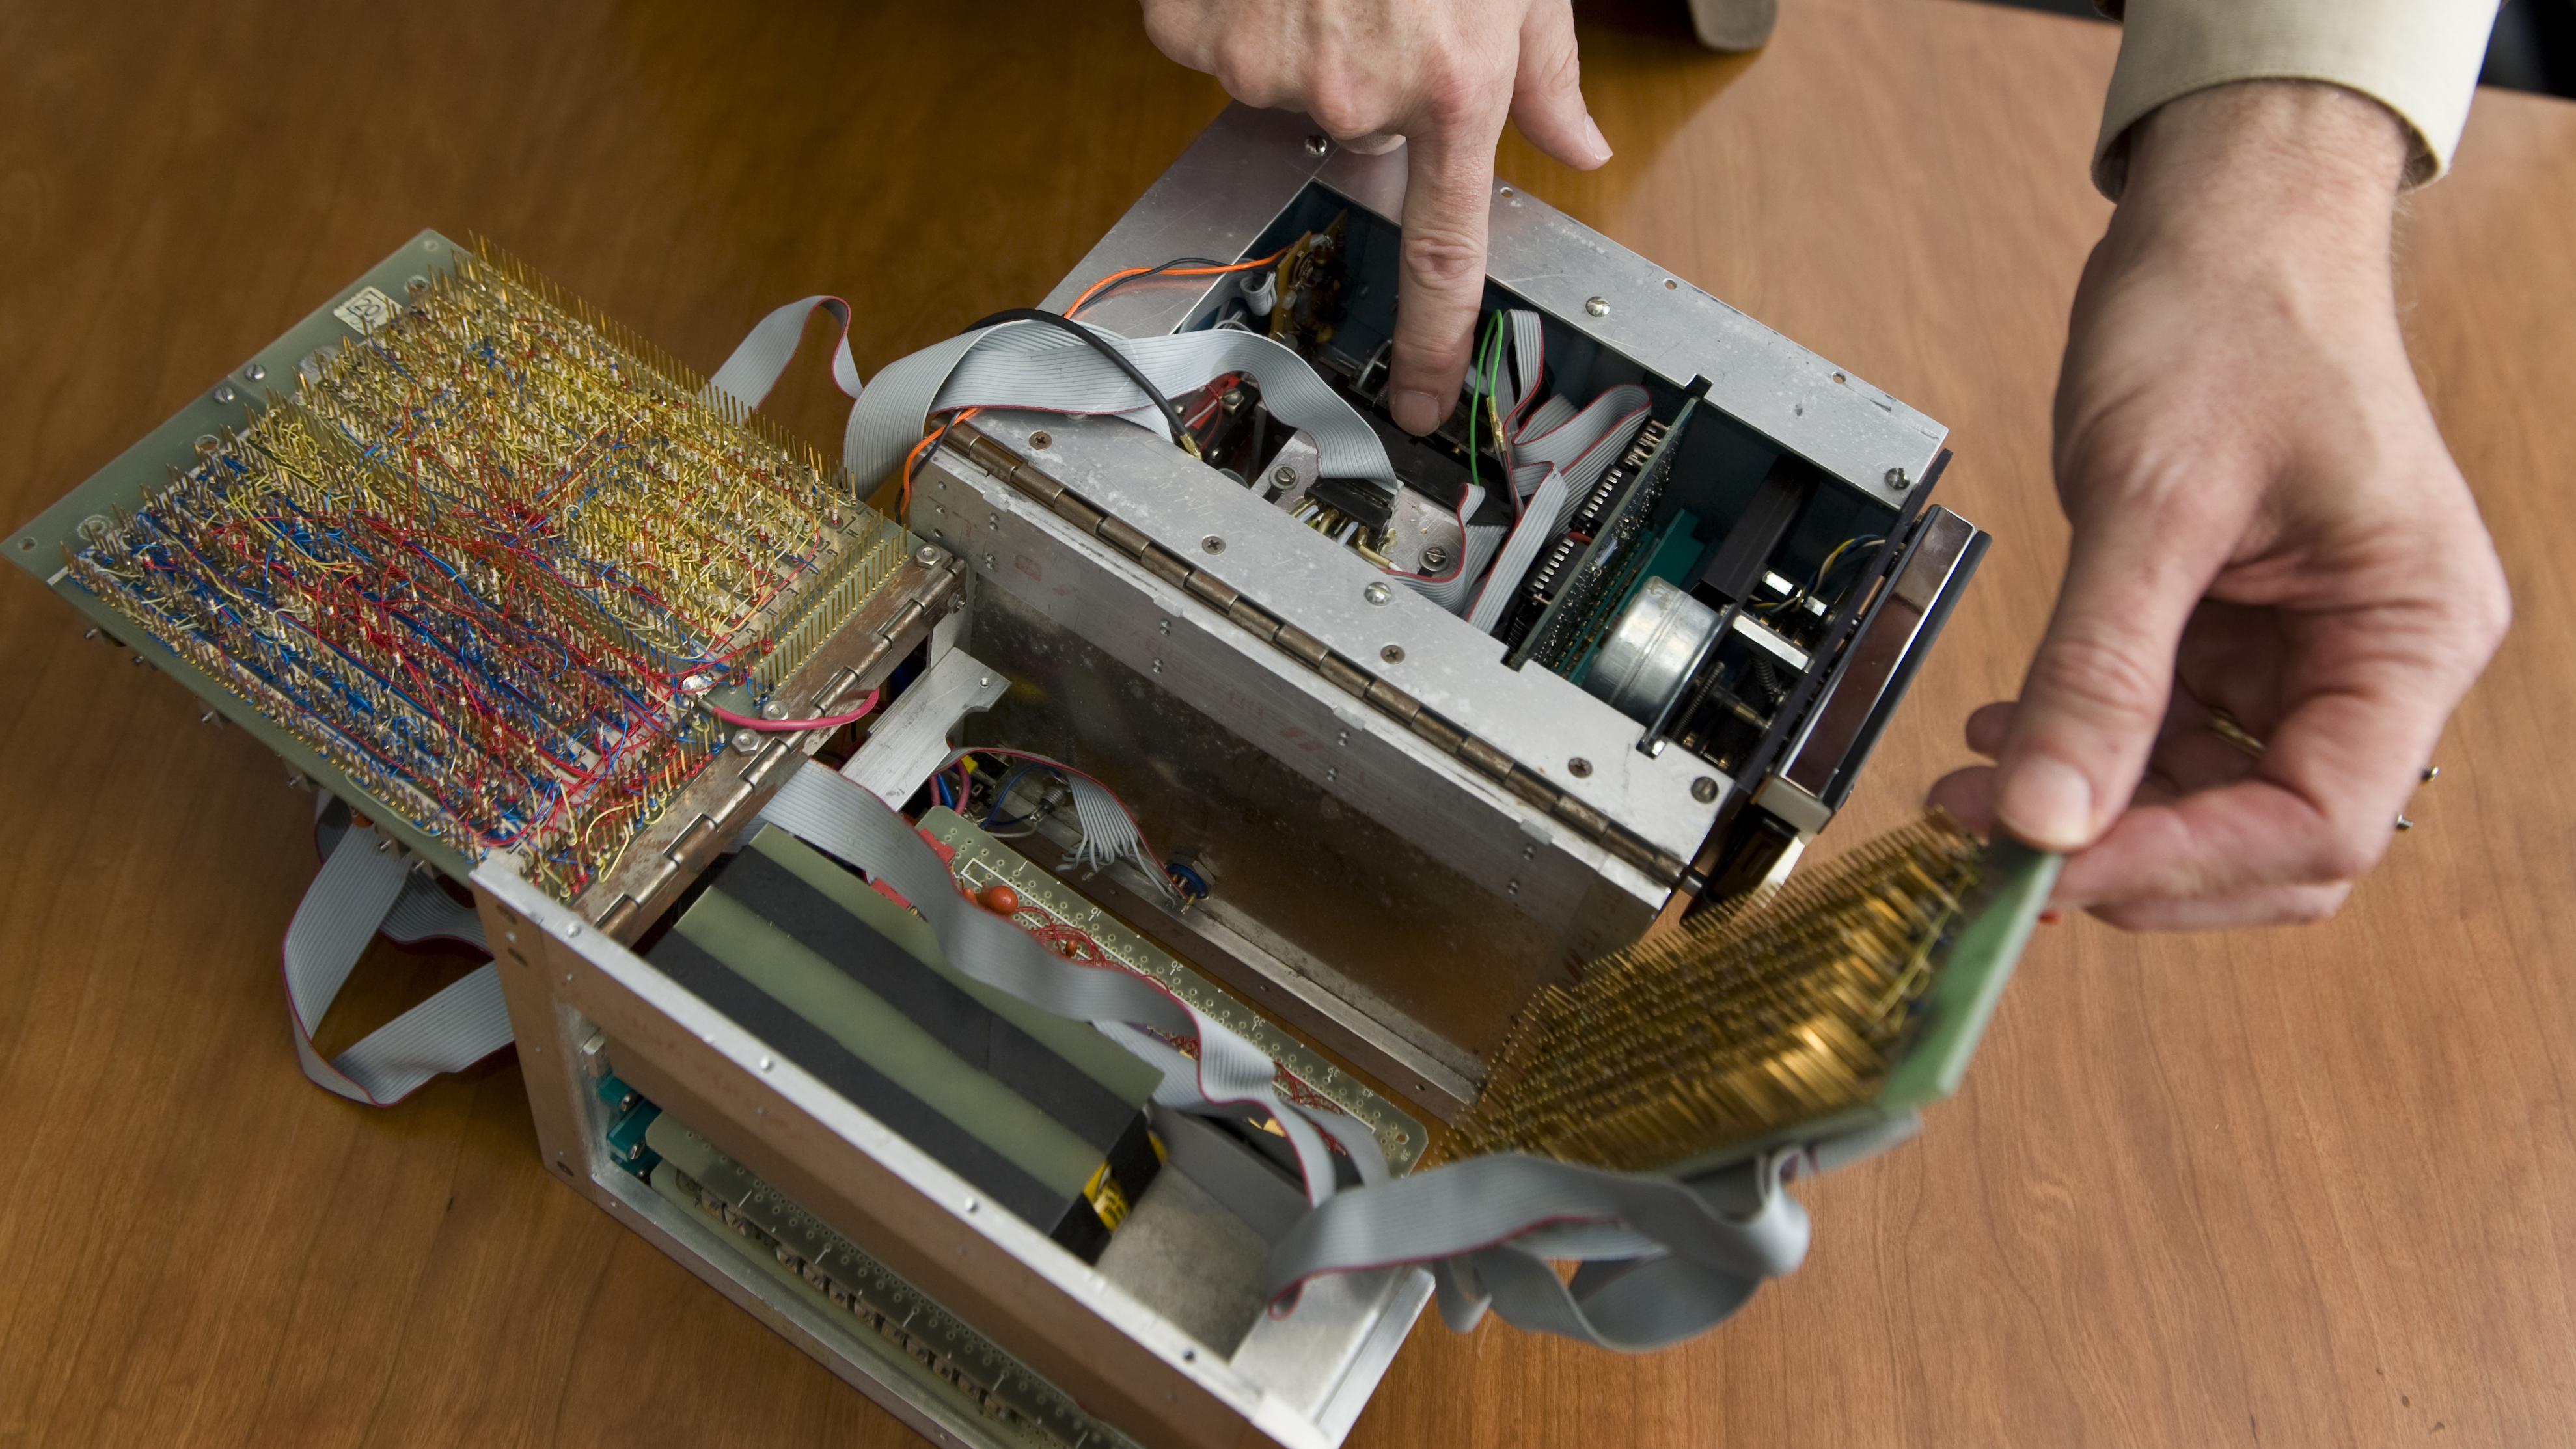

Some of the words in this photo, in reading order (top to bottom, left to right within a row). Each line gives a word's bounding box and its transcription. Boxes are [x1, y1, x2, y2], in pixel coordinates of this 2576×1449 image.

[355, 298, 381, 317] 20
[847, 528, 859, 539] H
[808, 567, 819, 576] F
[786, 587, 799, 597] E
[746, 628, 757, 637] C
[1091, 907, 1101, 917] 10
[1171, 961, 1183, 971] 20
[1253, 1016, 1265, 1027] 30
[1328, 1067, 1340, 1077] 39
[1362, 1089, 1374, 1098] 43
[1400, 1149, 1411, 1161] 38
